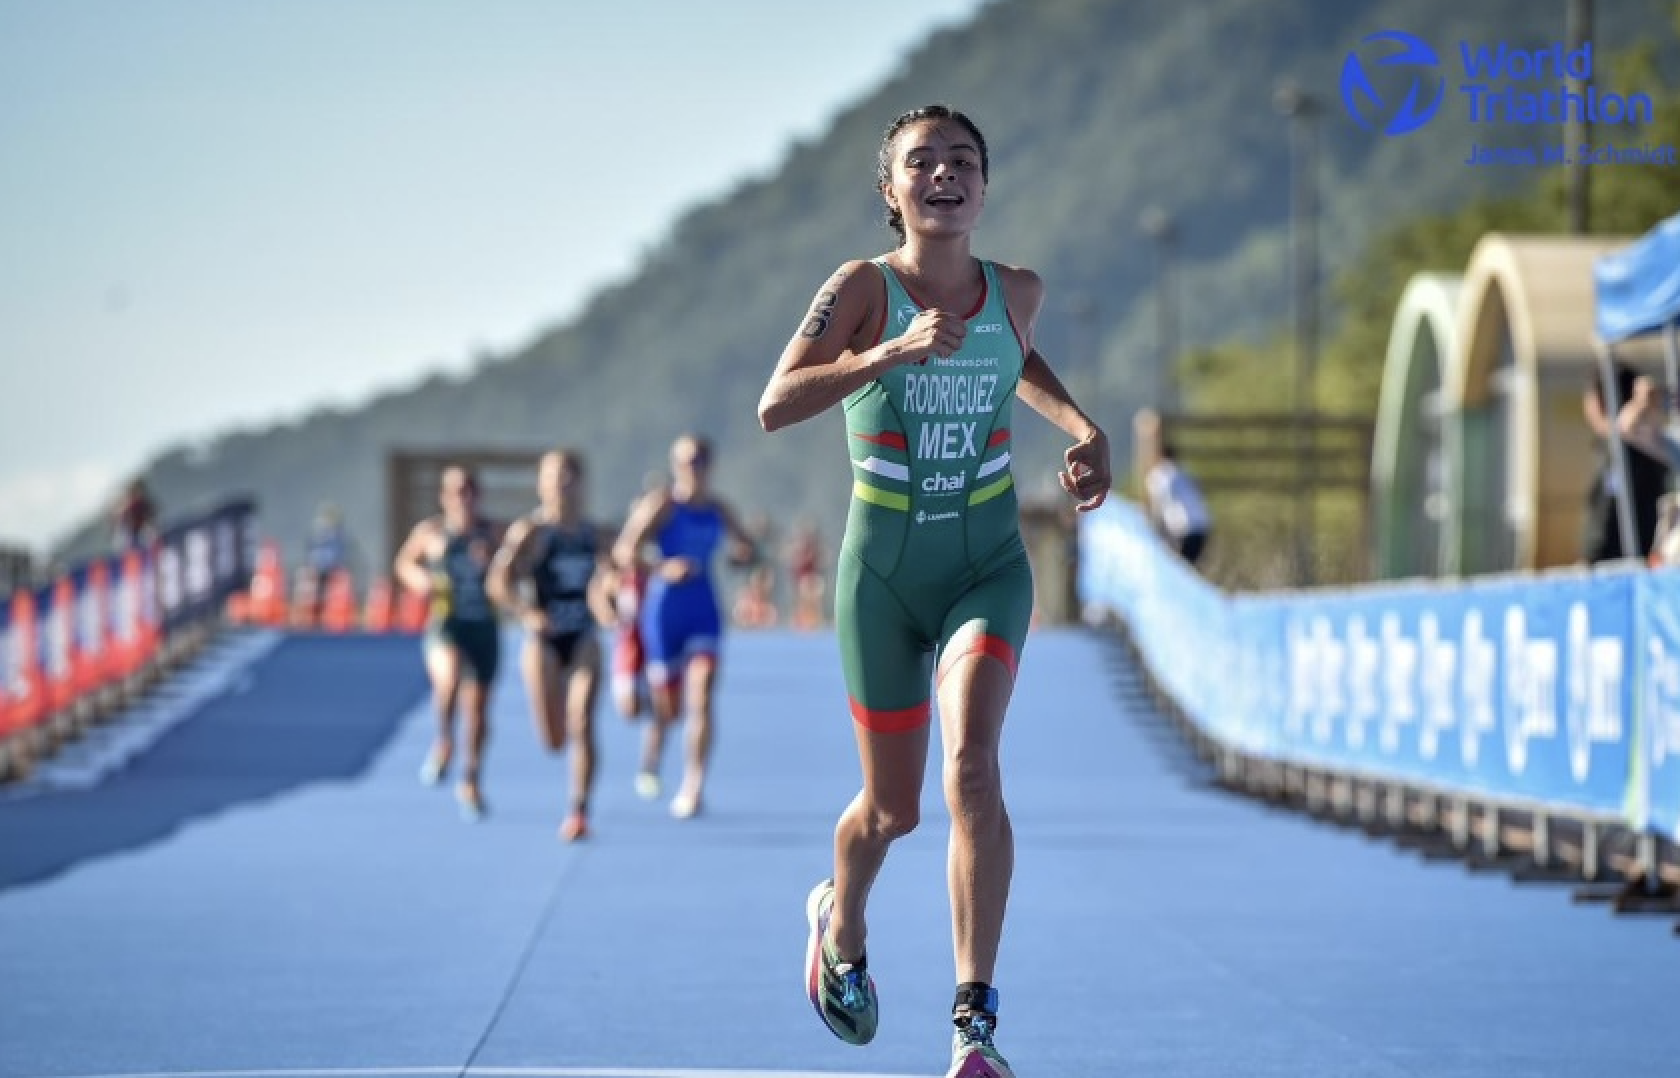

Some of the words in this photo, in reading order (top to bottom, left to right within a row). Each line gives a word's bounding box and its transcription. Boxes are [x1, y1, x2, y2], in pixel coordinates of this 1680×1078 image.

[903, 373, 999, 415] RODRIGUEZ
[917, 421, 977, 459] MEX
[921, 469, 967, 492] chai
